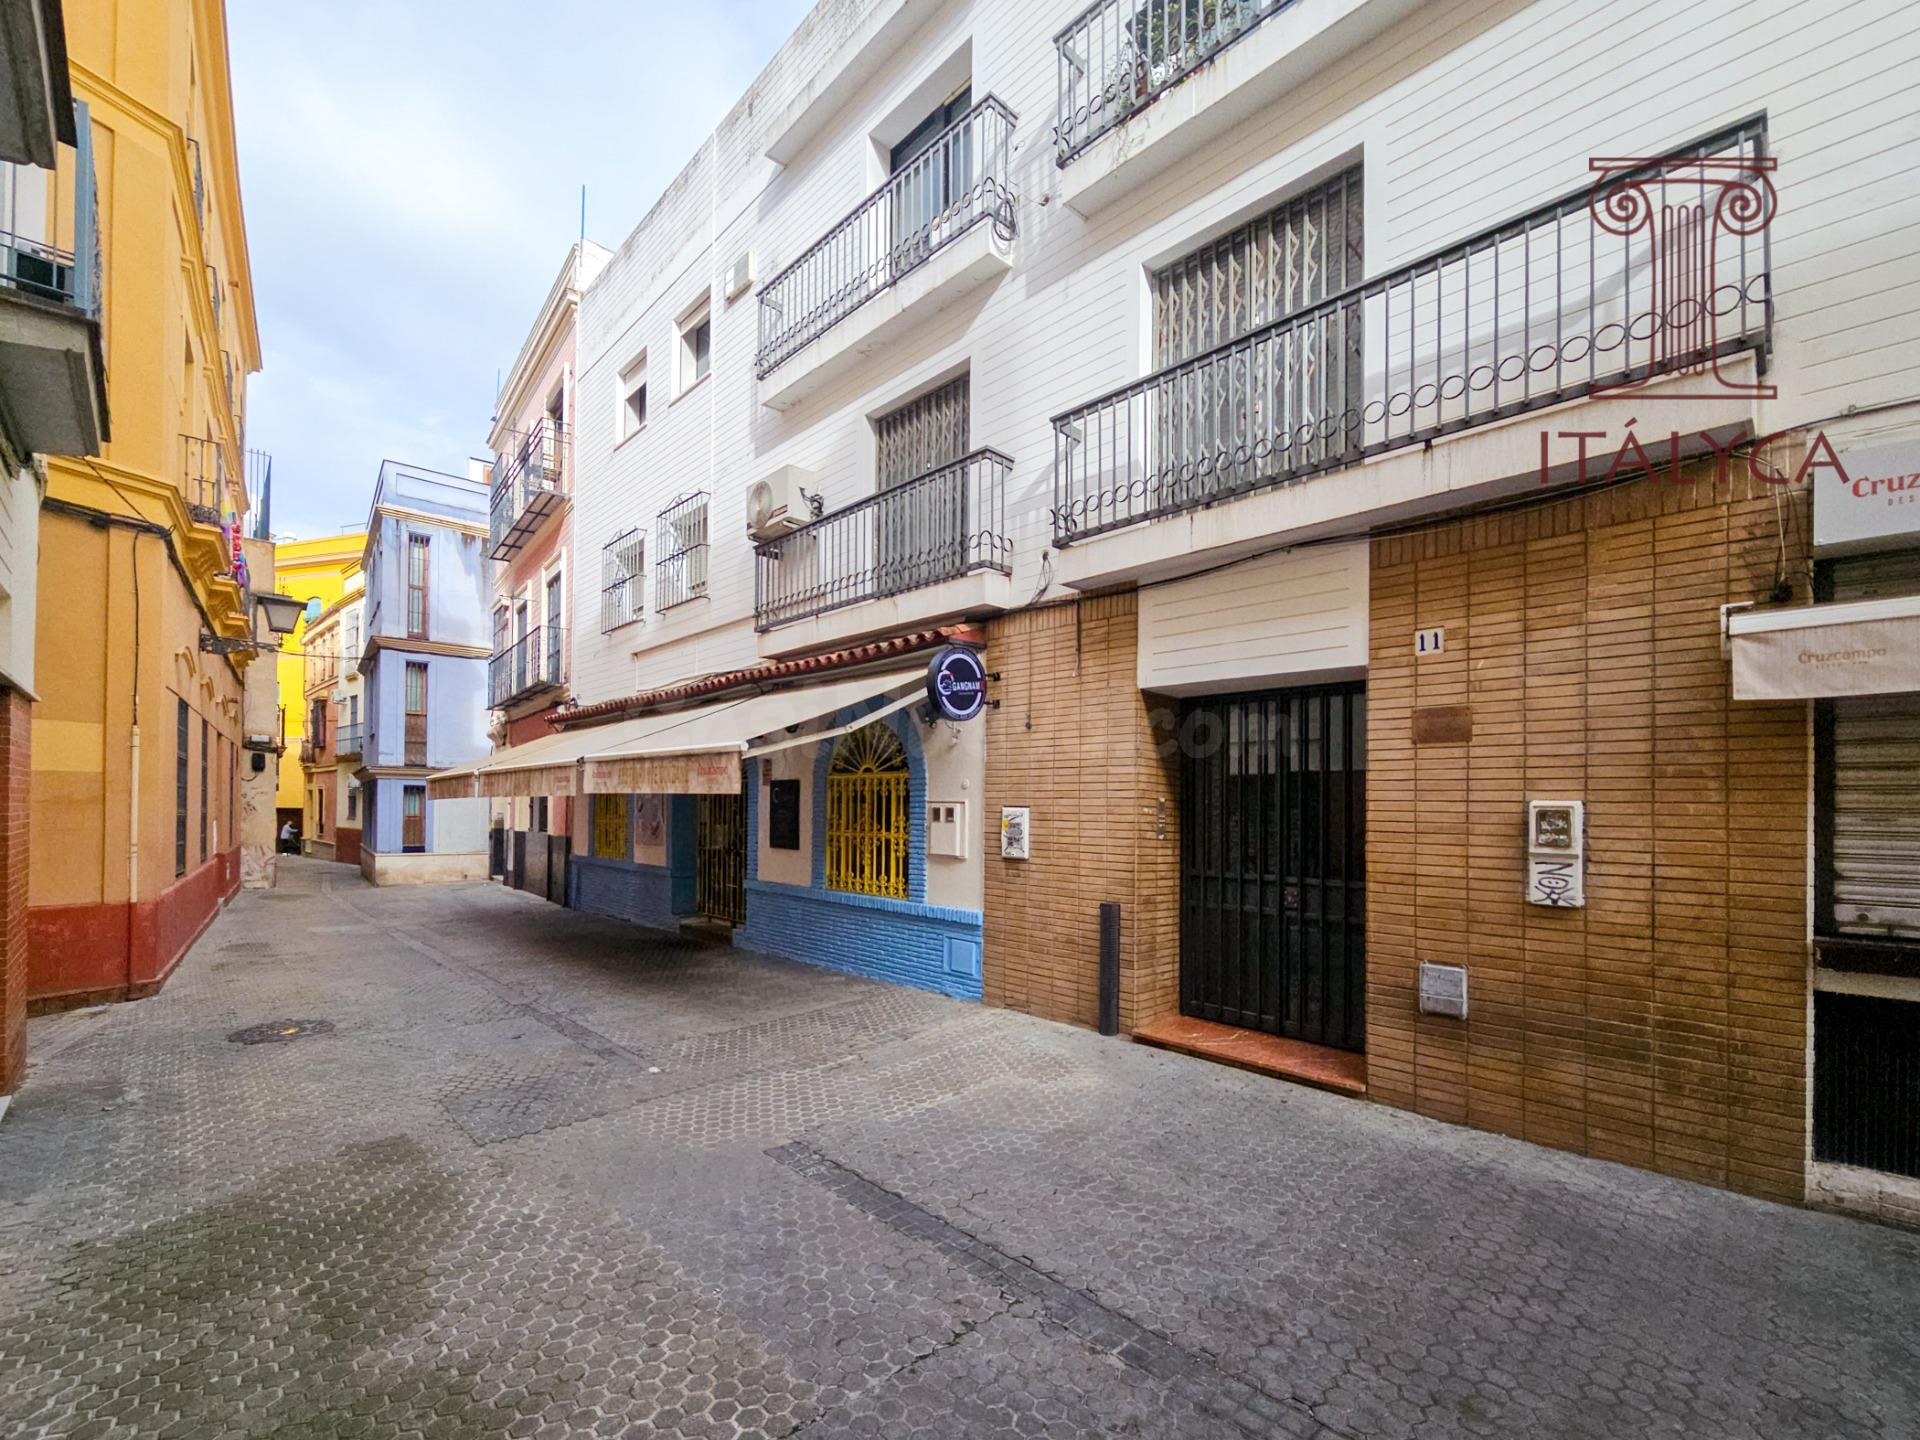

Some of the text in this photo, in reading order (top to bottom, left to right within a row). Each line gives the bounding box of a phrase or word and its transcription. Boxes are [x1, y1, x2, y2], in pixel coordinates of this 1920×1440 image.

[1418, 631, 1441, 652] 11
[1797, 647, 1887, 665] Cruzcampo
[952, 681, 980, 691] GANGNAM
